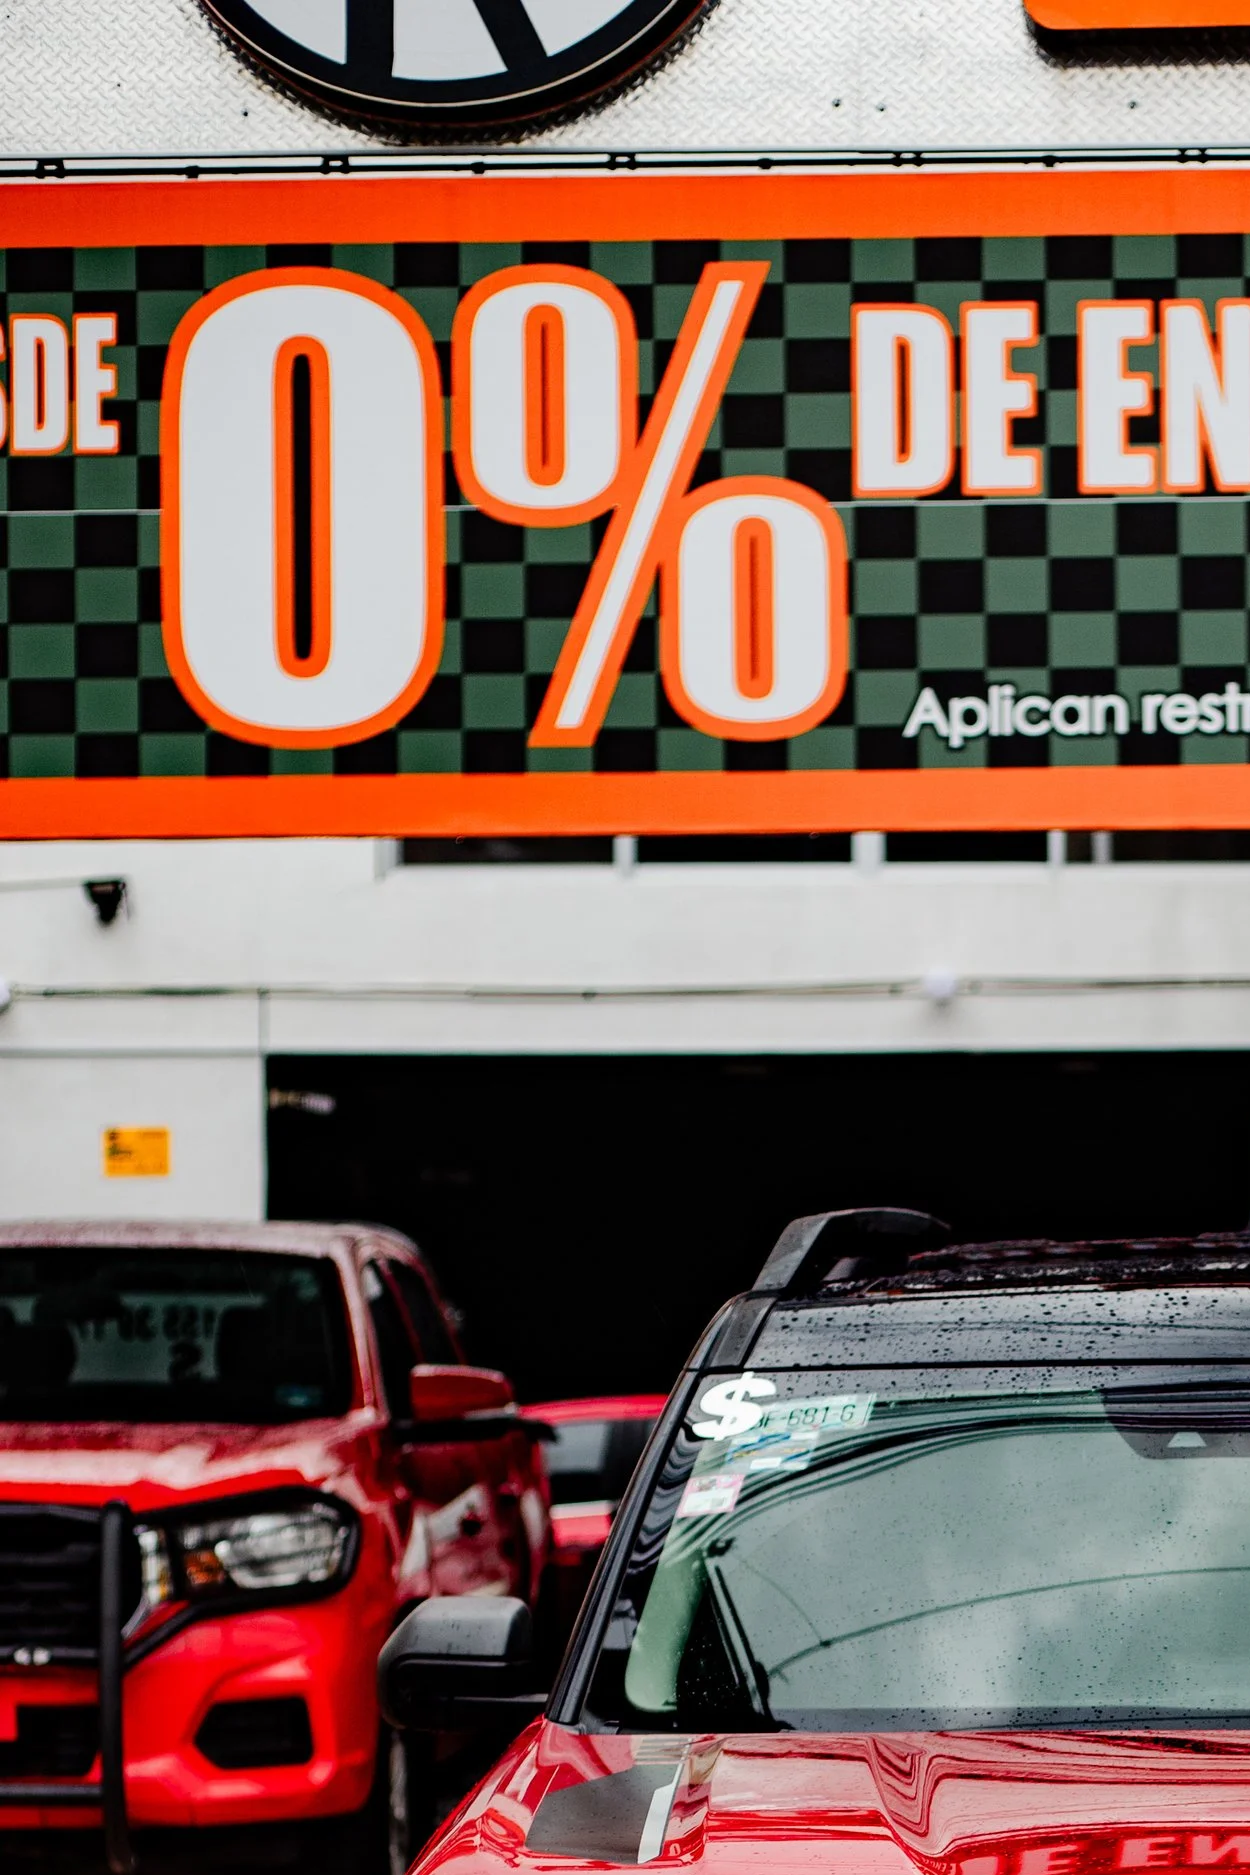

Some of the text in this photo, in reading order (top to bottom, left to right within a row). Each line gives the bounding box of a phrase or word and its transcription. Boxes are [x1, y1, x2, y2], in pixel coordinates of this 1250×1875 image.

[851, 300, 1044, 498] DE
[0, 260, 847, 749] DE 0%
[903, 686, 1128, 748] Aplican
